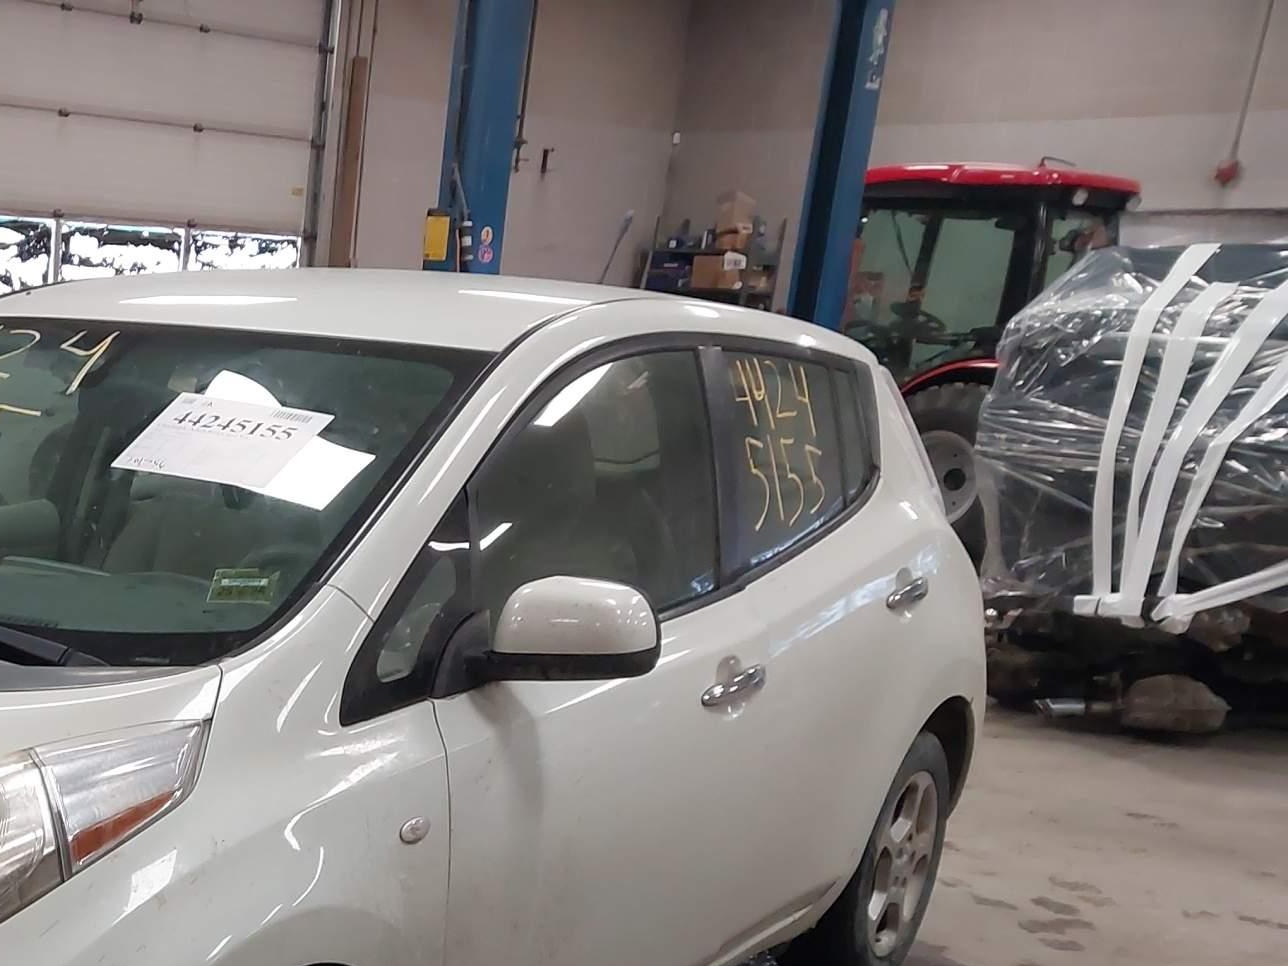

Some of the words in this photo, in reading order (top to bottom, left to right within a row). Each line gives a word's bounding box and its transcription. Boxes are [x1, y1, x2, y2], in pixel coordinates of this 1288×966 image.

[173, 410, 298, 441] 44245155
[729, 356, 817, 438] 4424
[744, 434, 826, 532] 5155
